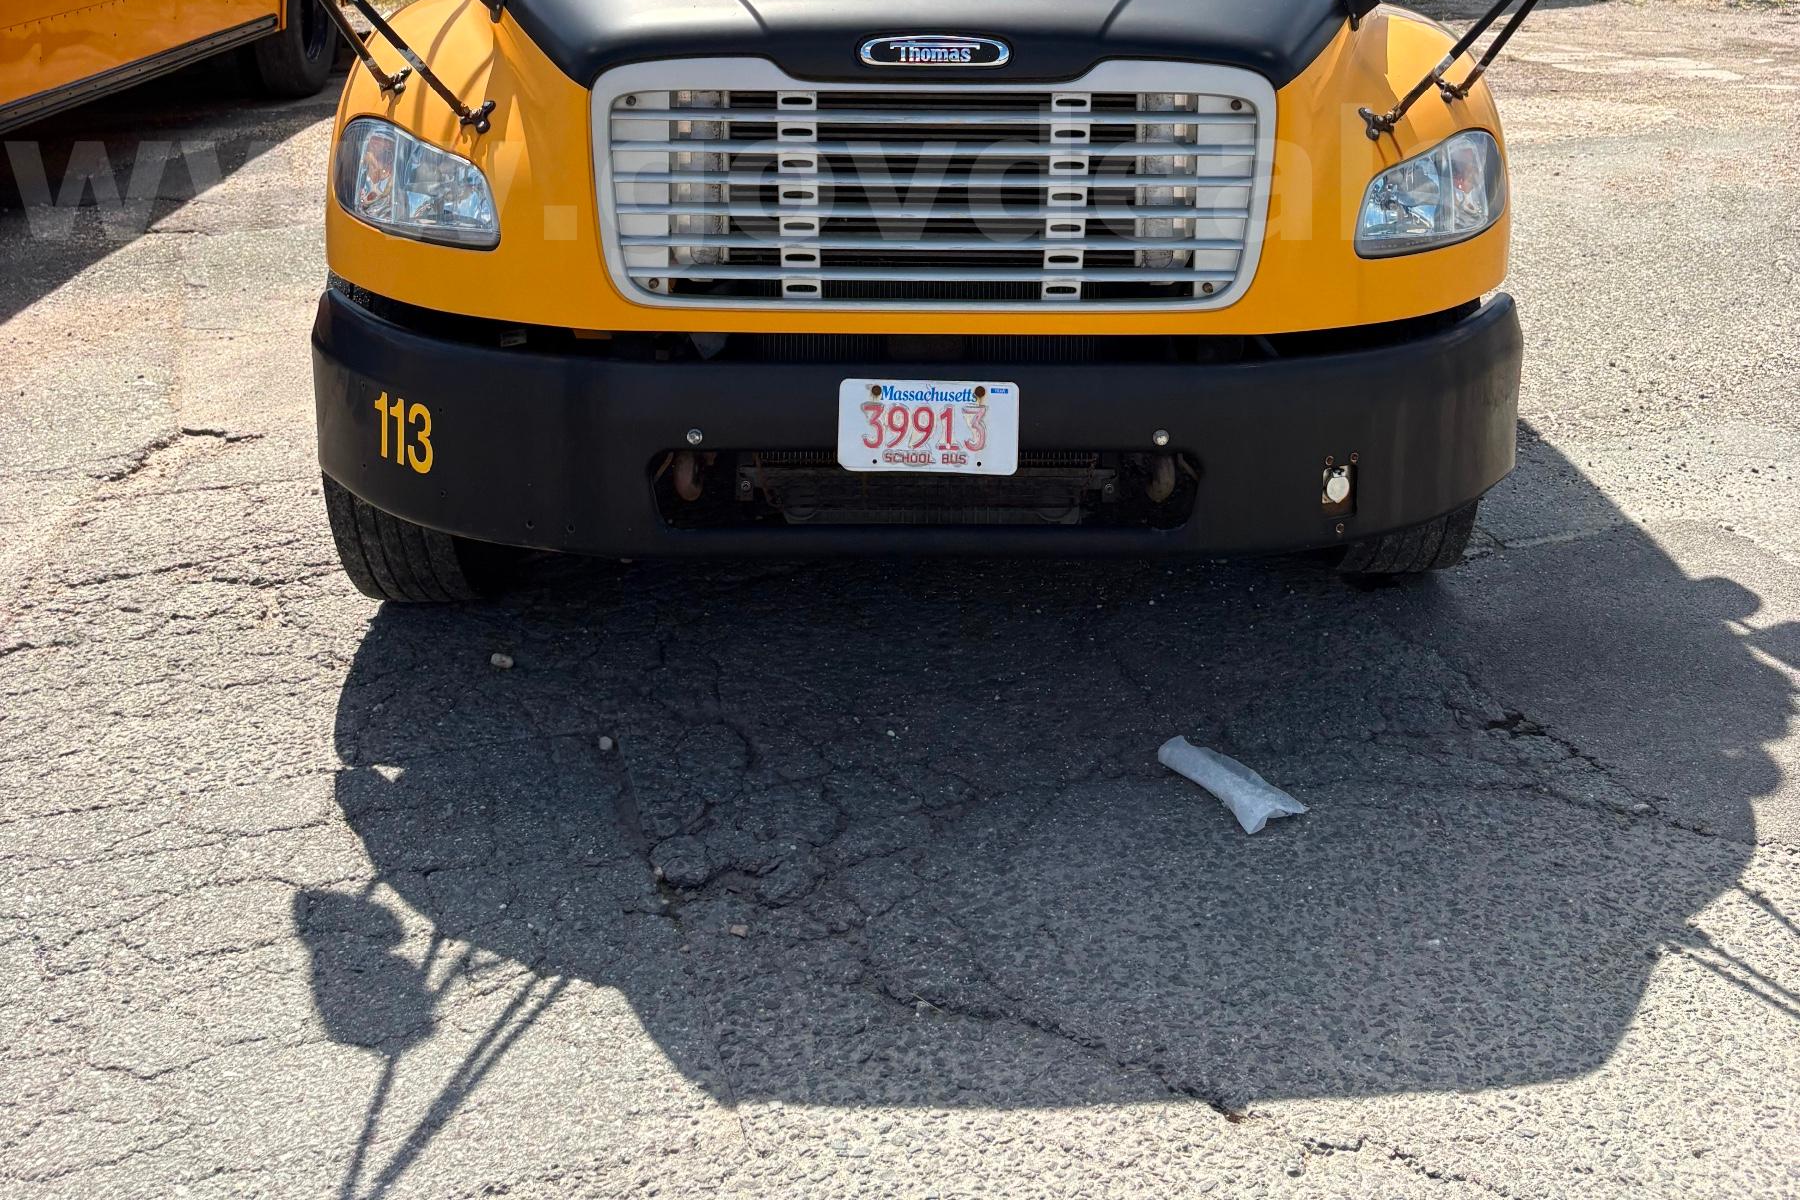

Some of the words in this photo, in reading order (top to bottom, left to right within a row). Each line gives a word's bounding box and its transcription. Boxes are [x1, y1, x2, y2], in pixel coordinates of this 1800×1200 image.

[890, 41, 980, 63] Thomas
[881, 385, 978, 404] Massachusetts
[374, 391, 434, 474] 113
[862, 403, 987, 452] 39913
[884, 452, 936, 465] SCHOOL
[941, 453, 967, 465] BUS
